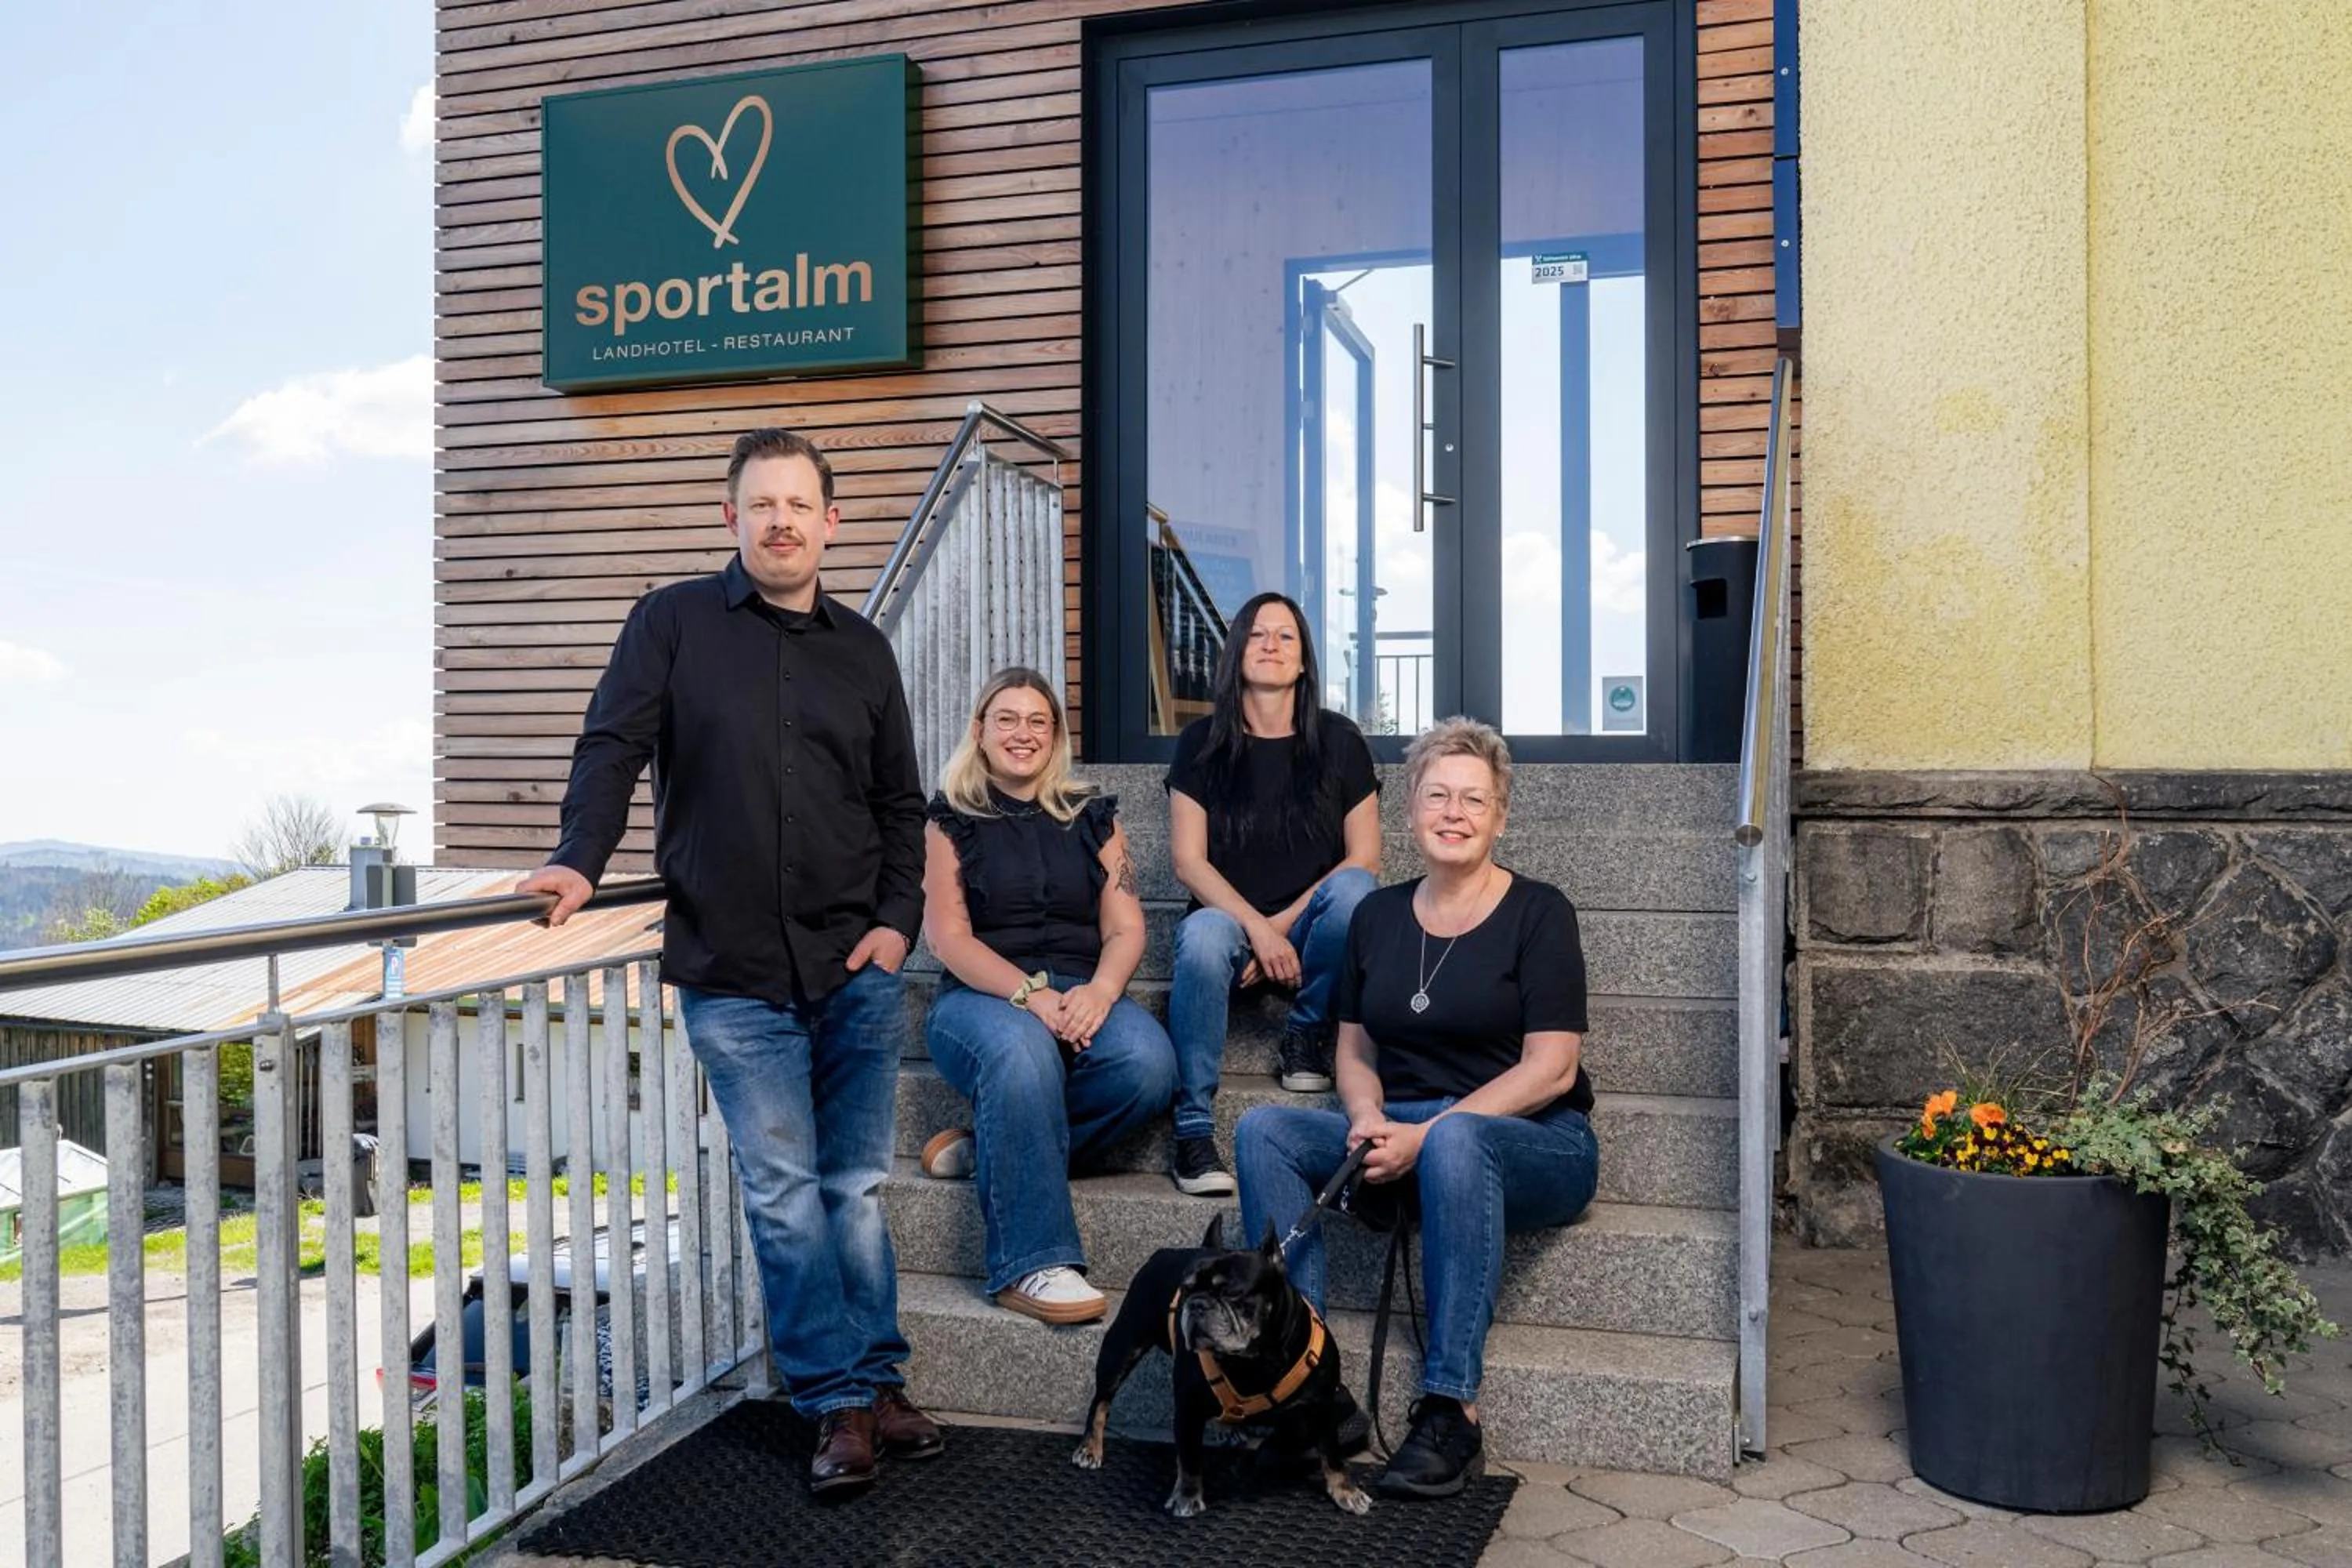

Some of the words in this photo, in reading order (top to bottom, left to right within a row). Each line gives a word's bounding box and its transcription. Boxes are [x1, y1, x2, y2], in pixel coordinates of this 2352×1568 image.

[1535, 266, 1564, 278] 2025
[575, 252, 873, 336] sportalm
[593, 339, 706, 361] LANDHOTEL
[724, 326, 855, 350] RESTAURANT
